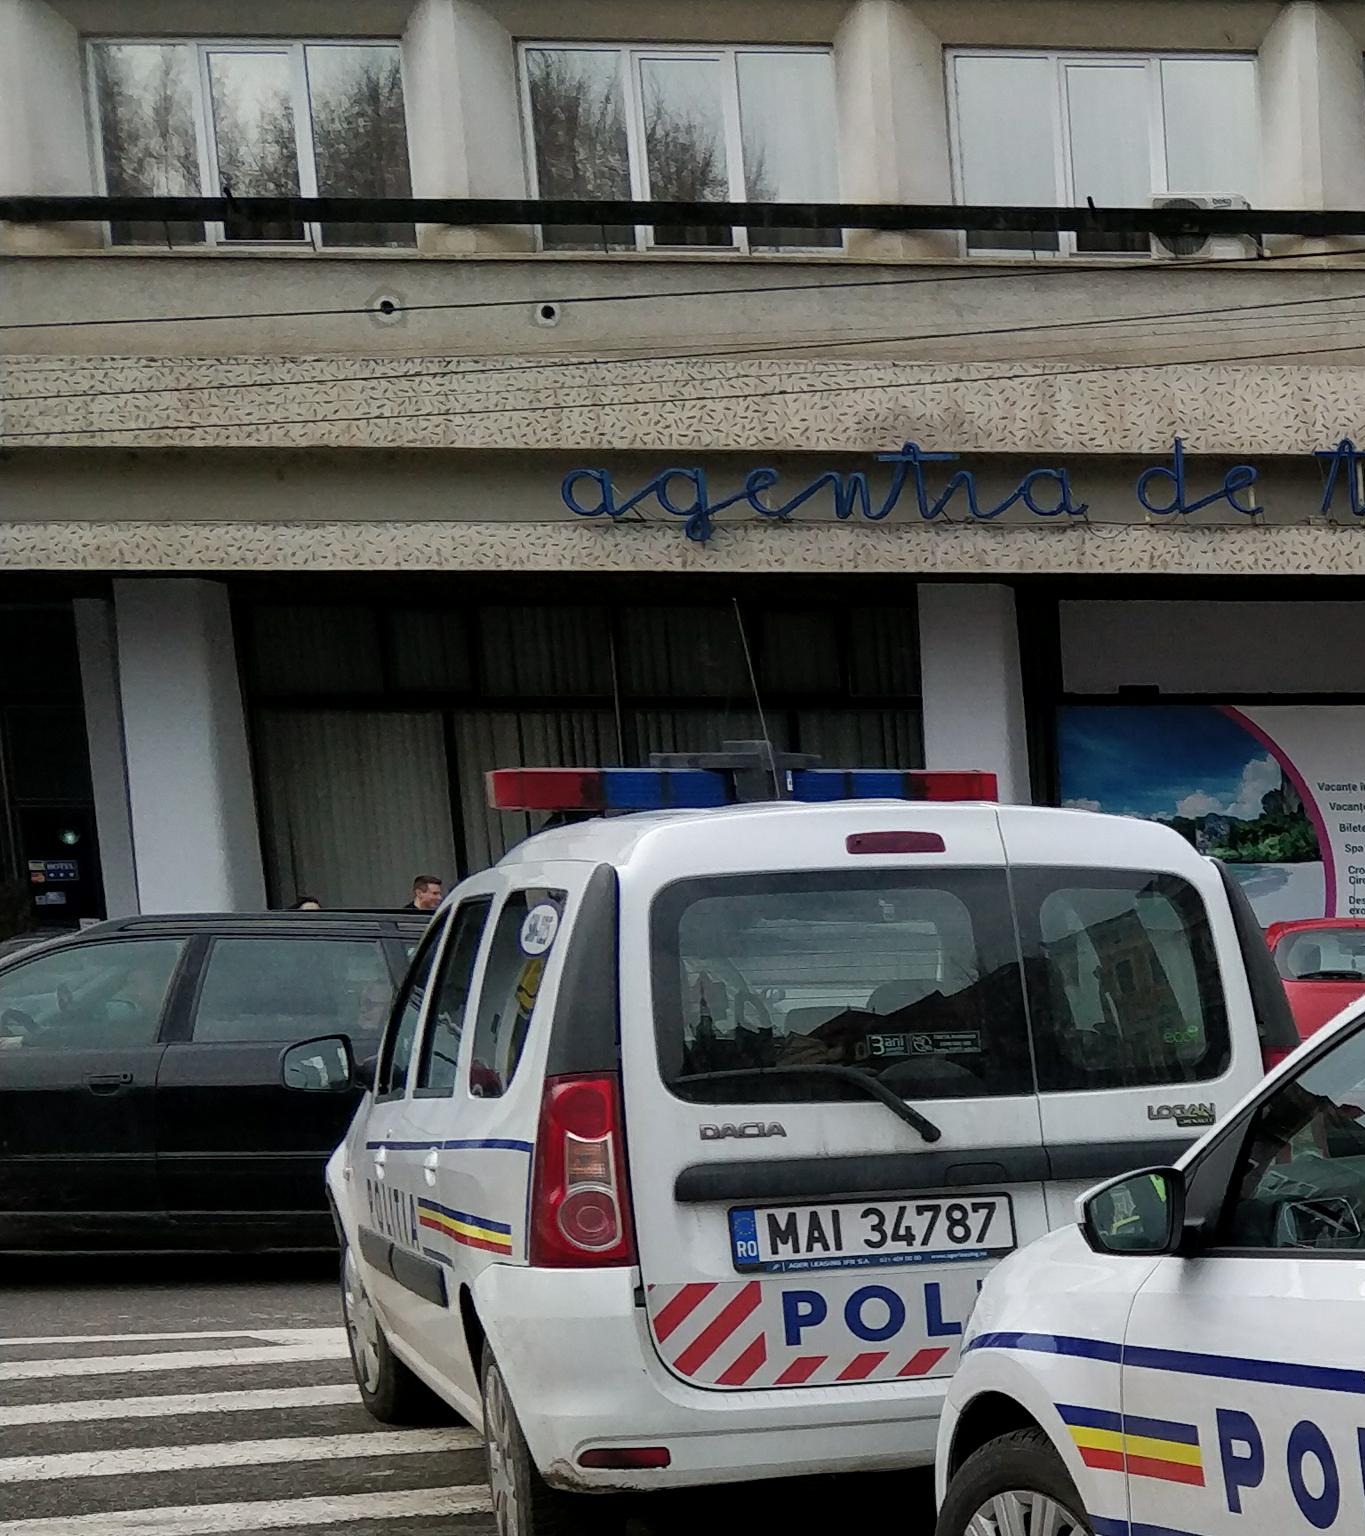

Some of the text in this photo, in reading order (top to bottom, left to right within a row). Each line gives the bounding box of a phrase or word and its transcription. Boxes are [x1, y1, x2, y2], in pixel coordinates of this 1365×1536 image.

[1137, 437, 1263, 516] de
[1344, 843, 1364, 855] Spa
[1147, 1103, 1217, 1121] LOGAN
[700, 1121, 787, 1140] DACIA
[736, 1202, 997, 1257] RO MAI 34787
[810, 1259, 842, 1269] LEASING
[781, 1279, 984, 1347] POL
